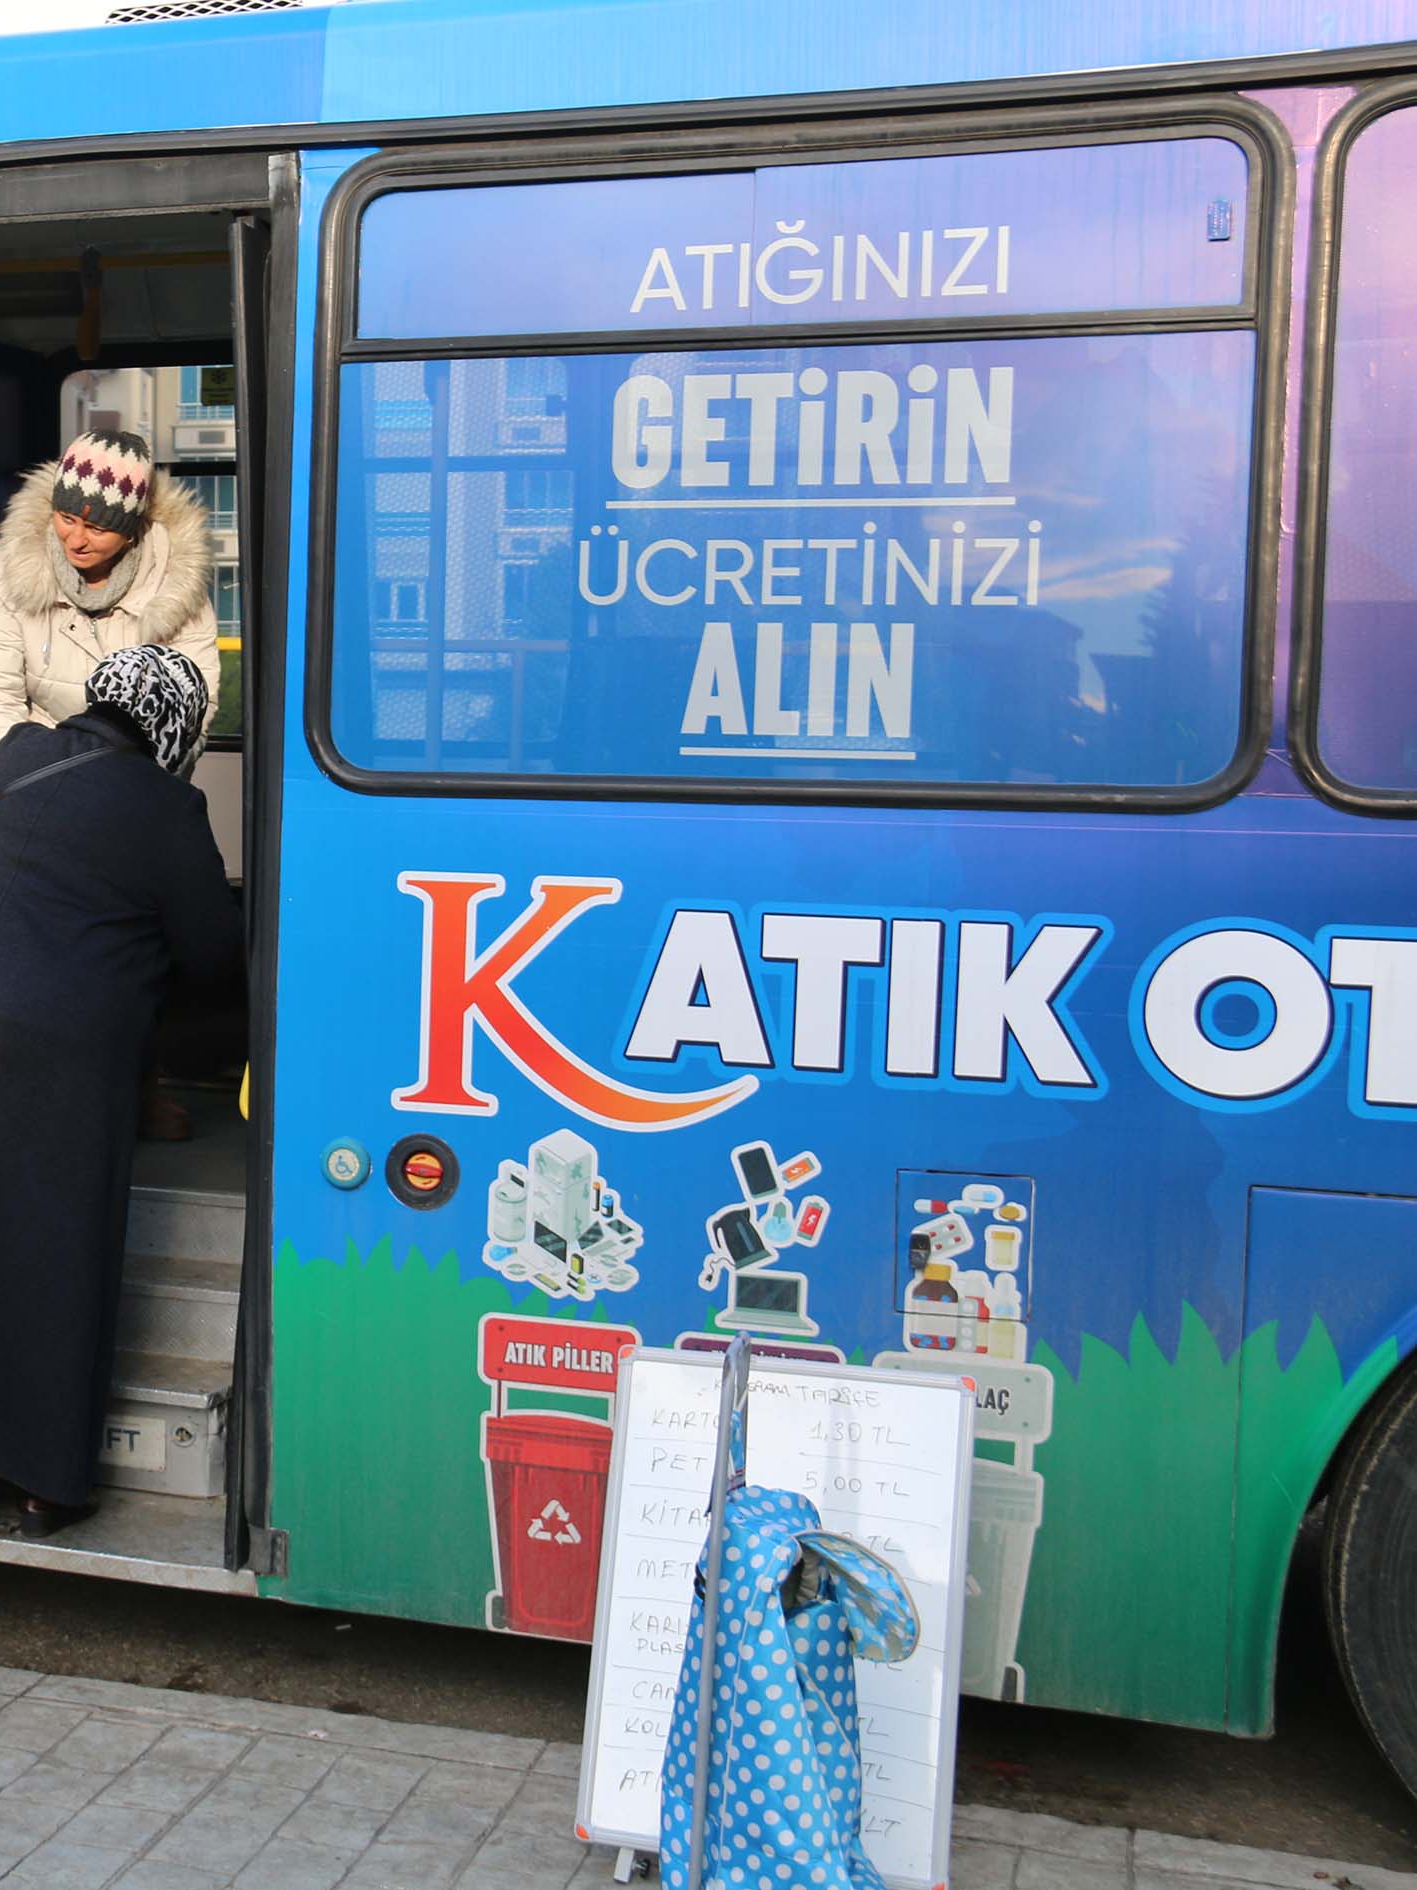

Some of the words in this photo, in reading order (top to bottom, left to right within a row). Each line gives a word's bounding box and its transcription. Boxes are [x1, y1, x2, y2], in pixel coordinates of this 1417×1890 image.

[631, 220, 1010, 313] ATIĞINIZI
[579, 519, 1043, 608] ÜCRETİNİZİ
[680, 622, 915, 738] ALIN
[504, 1341, 547, 1367] ATIK
[551, 1342, 614, 1374] PİLLER
[805, 1420, 862, 1442] 1,30
[872, 1425, 910, 1446] TL
[651, 1446, 709, 1472] PET
[803, 1470, 862, 1495] 5,00
[875, 1481, 910, 1497] TL
[641, 1500, 711, 1527] KİTA
[861, 1762, 892, 1781] TL
